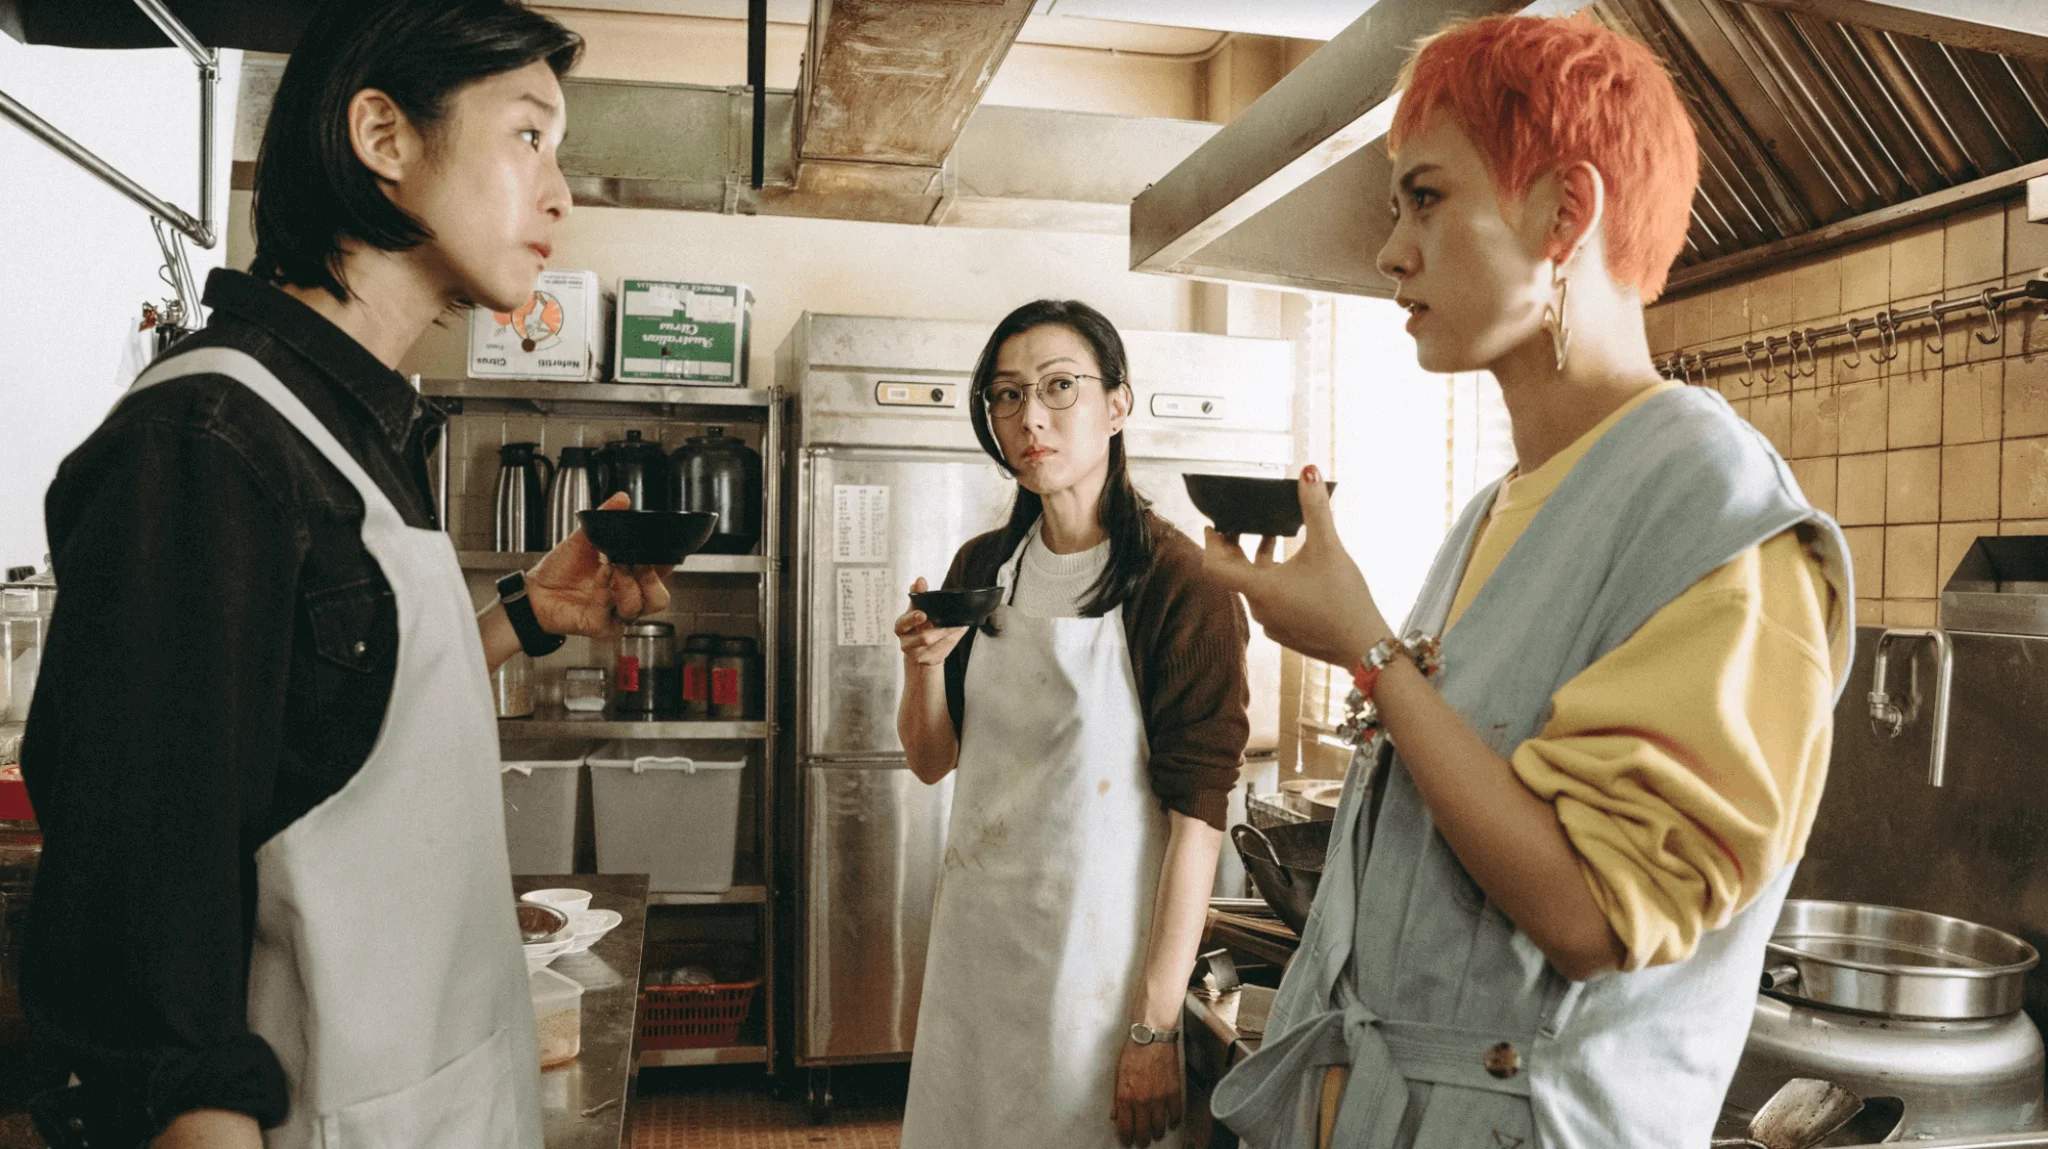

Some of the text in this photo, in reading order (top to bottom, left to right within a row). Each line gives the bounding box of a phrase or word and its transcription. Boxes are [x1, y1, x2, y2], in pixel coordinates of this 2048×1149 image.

[690, 285, 726, 293] PRODUCE
[659, 322, 699, 335] Citrus
[641, 333, 714, 349] Australian
[476, 357, 580, 368] Nefertiti Citrus
